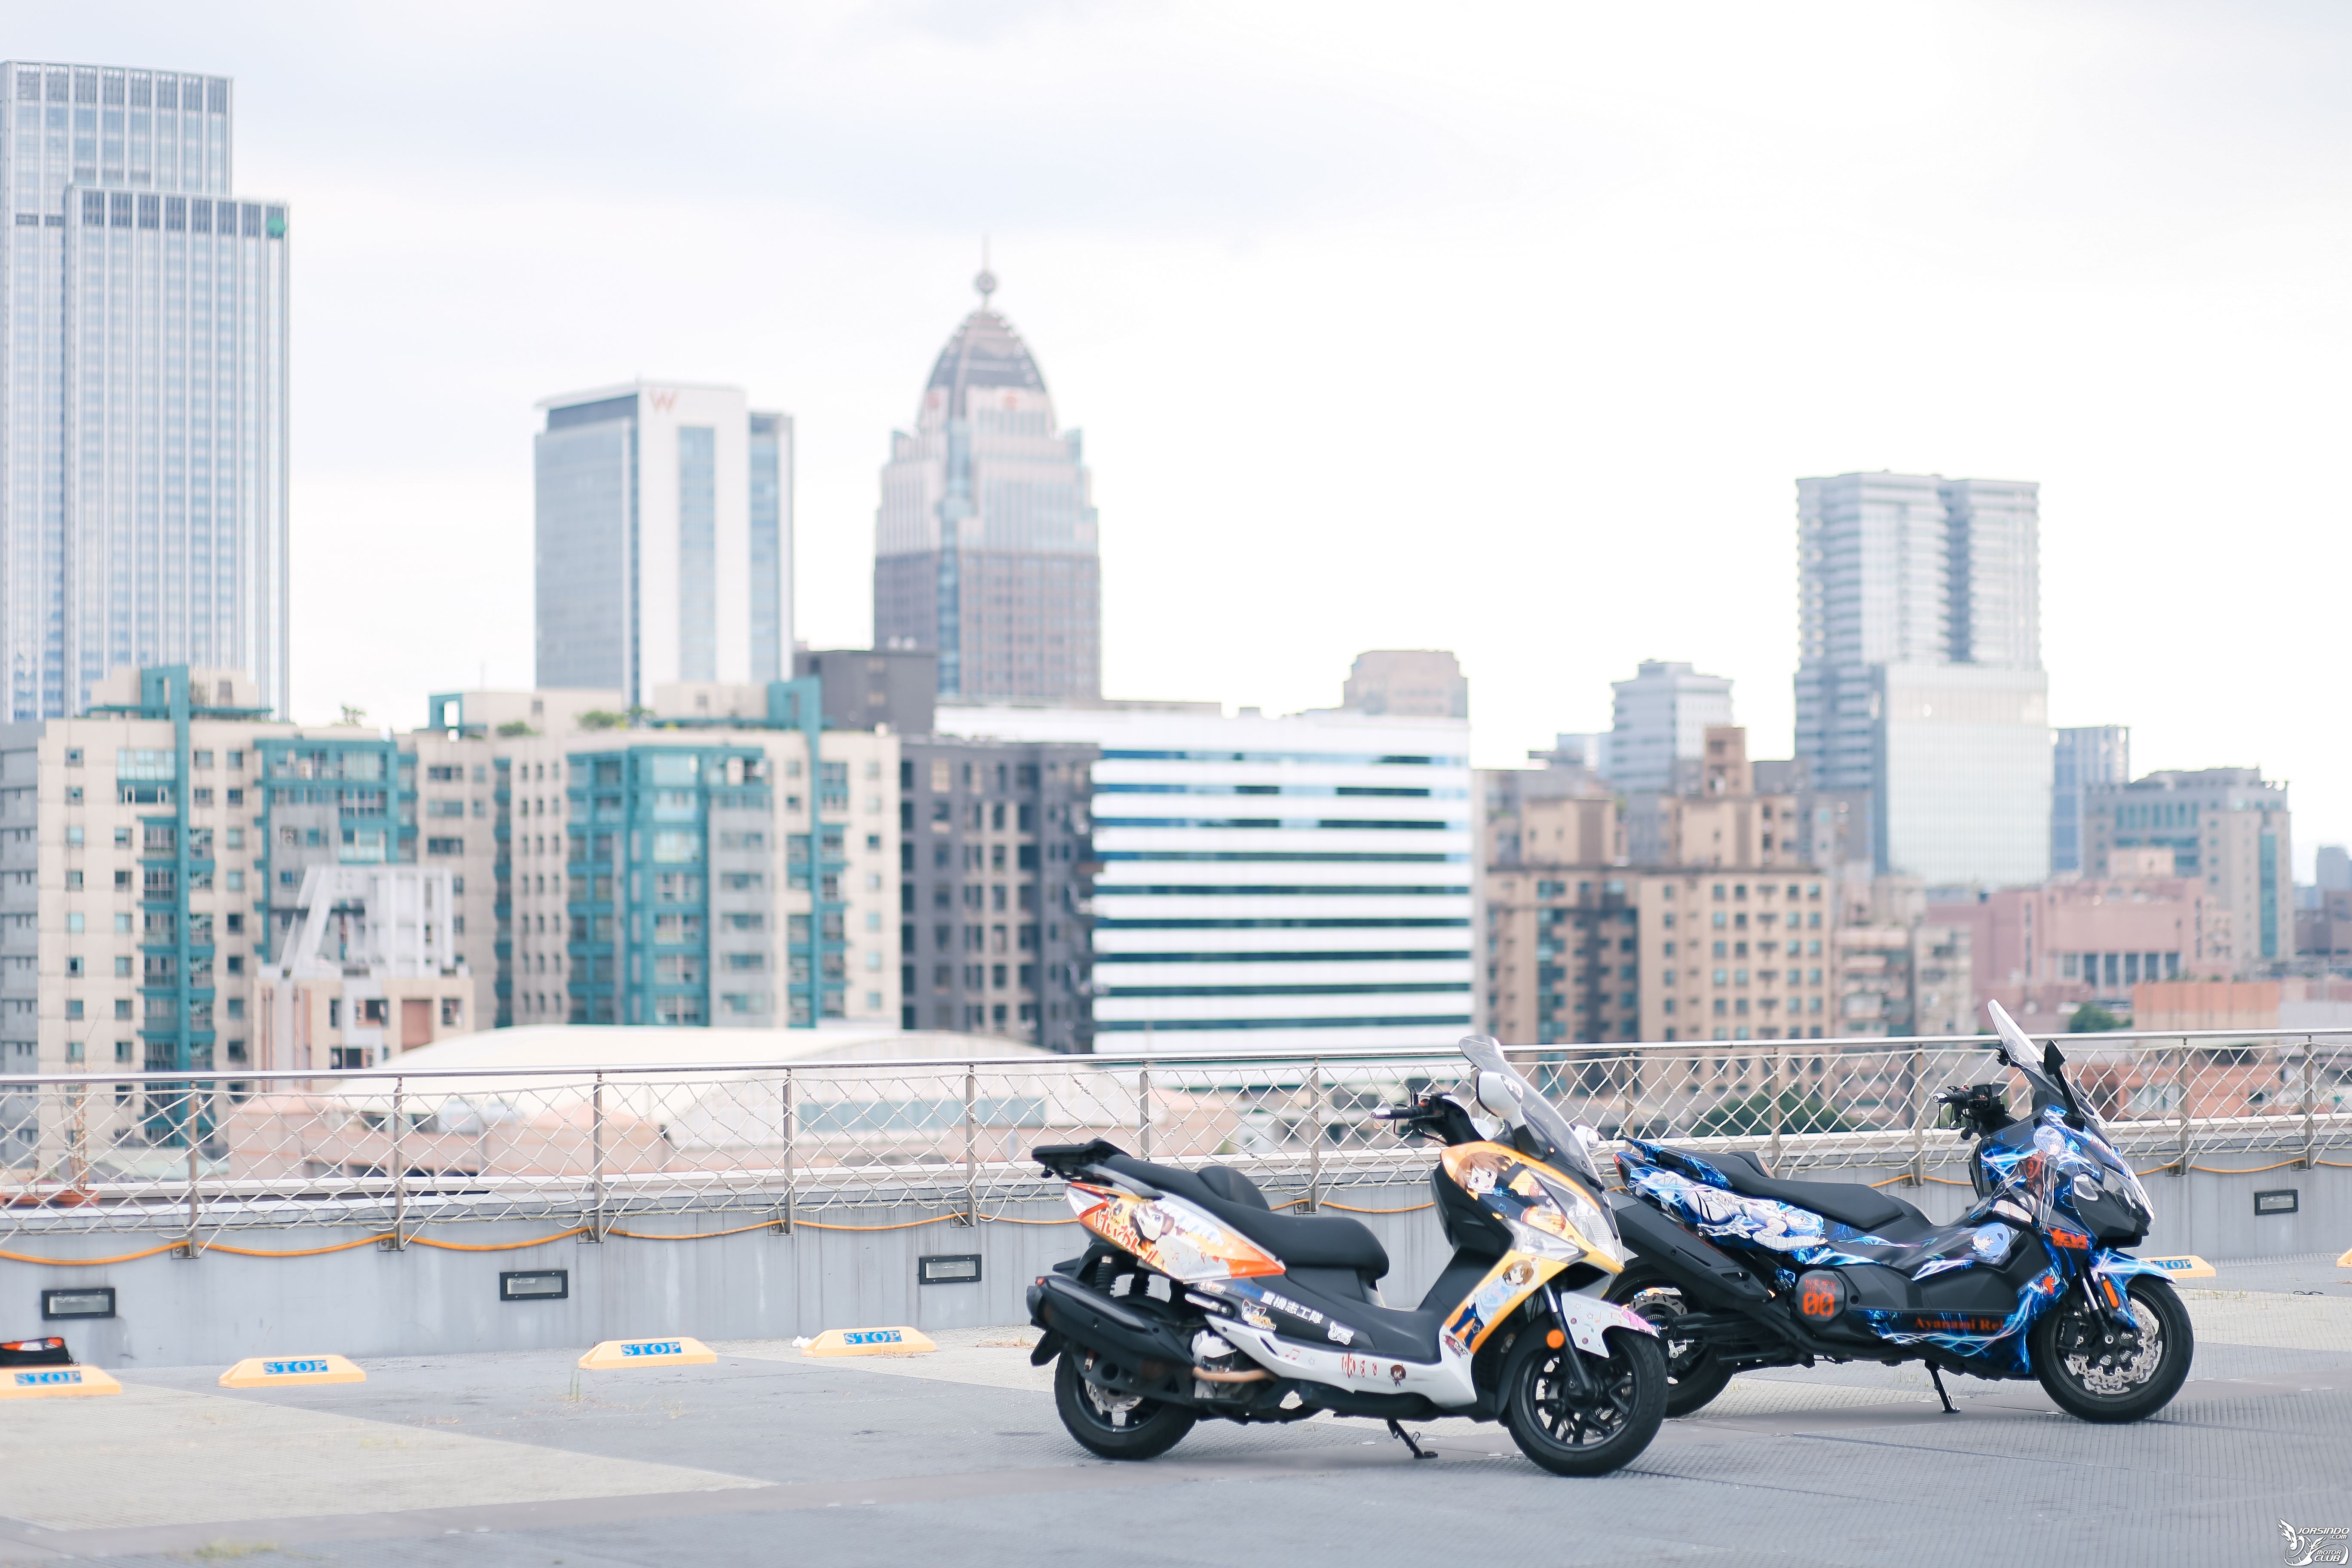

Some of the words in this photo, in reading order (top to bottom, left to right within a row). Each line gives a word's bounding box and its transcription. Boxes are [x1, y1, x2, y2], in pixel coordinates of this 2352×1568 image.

[2155, 1260, 2191, 1269] TOP
[1803, 1292, 1834, 1317] 00
[1914, 1317, 1976, 1331] Ayanami
[1979, 1319, 2004, 1330] Rei
[845, 1331, 900, 1344] STOP
[622, 1343, 680, 1356] STOP
[264, 1361, 326, 1374] STOP
[15, 1372, 81, 1385] STOP
